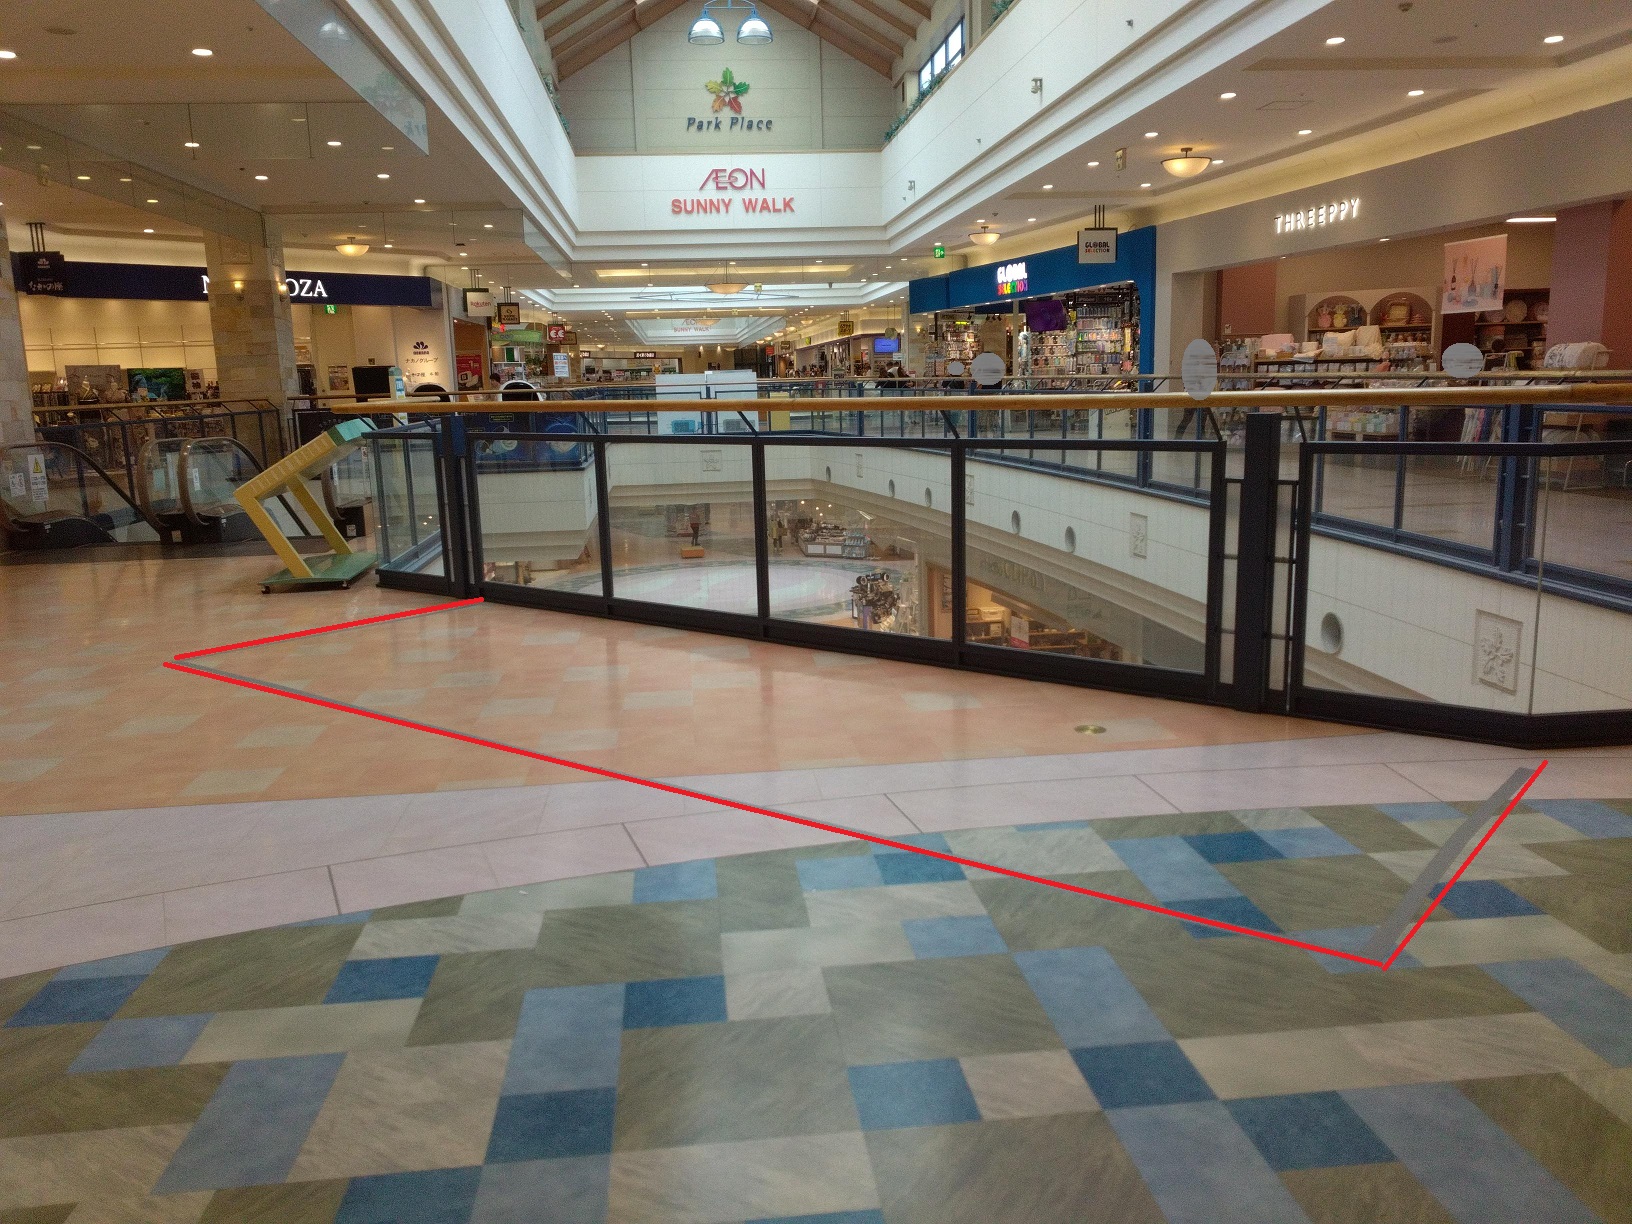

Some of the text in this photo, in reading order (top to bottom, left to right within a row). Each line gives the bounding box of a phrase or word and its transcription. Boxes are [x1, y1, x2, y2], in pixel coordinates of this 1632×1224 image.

[687, 116, 774, 131] Park Place
[671, 197, 796, 215] SUNNY WALK
[1274, 197, 1361, 234] THREEPPY
